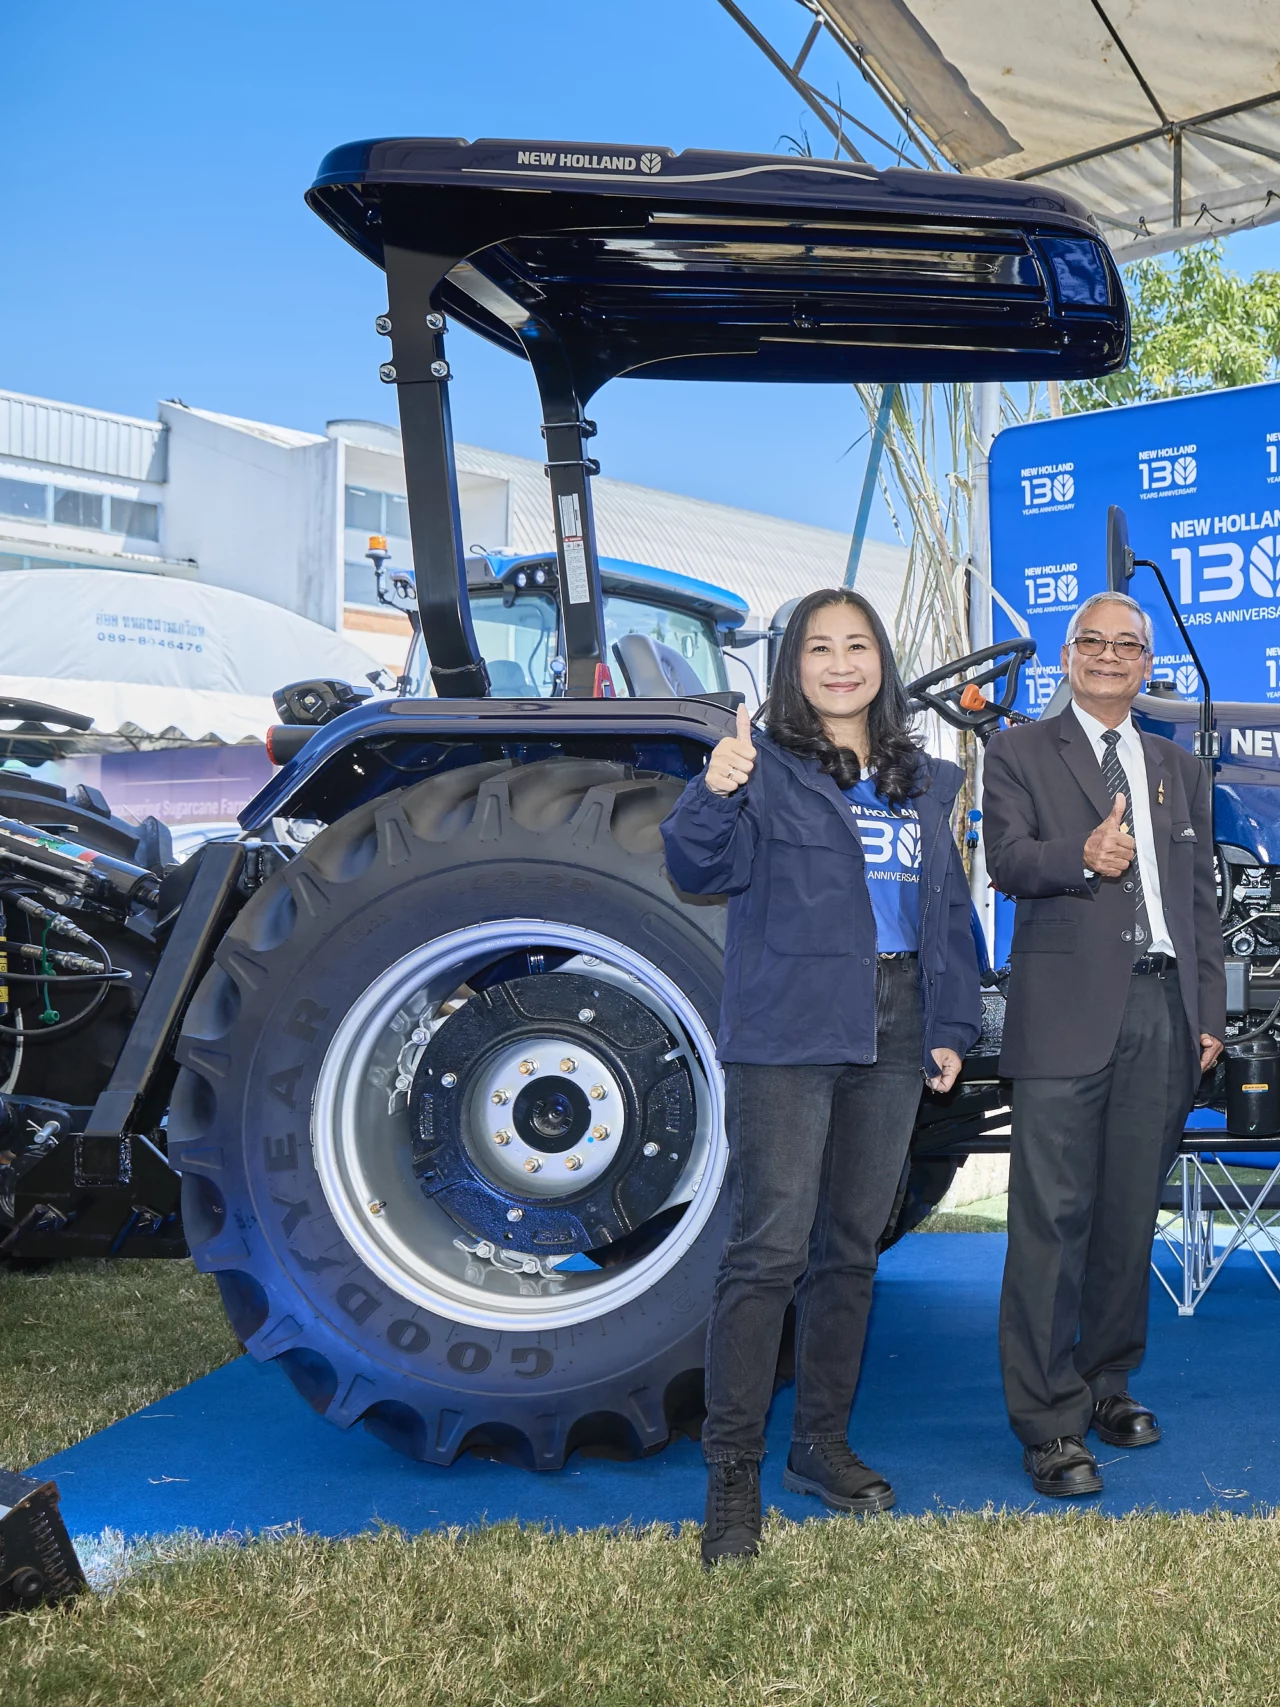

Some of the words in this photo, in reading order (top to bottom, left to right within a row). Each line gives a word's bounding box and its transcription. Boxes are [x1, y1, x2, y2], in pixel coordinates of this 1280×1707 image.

[517, 151, 556, 166] NEW
[560, 153, 636, 170] HOLLAND
[1139, 450, 1157, 460] NEW
[1158, 444, 1196, 457] HOLLAND
[1021, 467, 1038, 477] NEW
[1039, 463, 1074, 474] HOLLAND
[1159, 487, 1197, 497] ANNIVERSARY
[1040, 504, 1074, 513] ANNIVERSARY
[1172, 518, 1211, 539] NEW
[1025, 567, 1042, 576] NEW
[1043, 563, 1077, 574] HOLLAND
[1044, 604, 1078, 613] ANNIVERSARY
[1161, 654, 1194, 665] HOLLAN
[1043, 665, 1062, 675] HOLL
[867, 870, 920, 883] ANNIVERSA
[265, 996, 555, 1379] GOODYEAR
